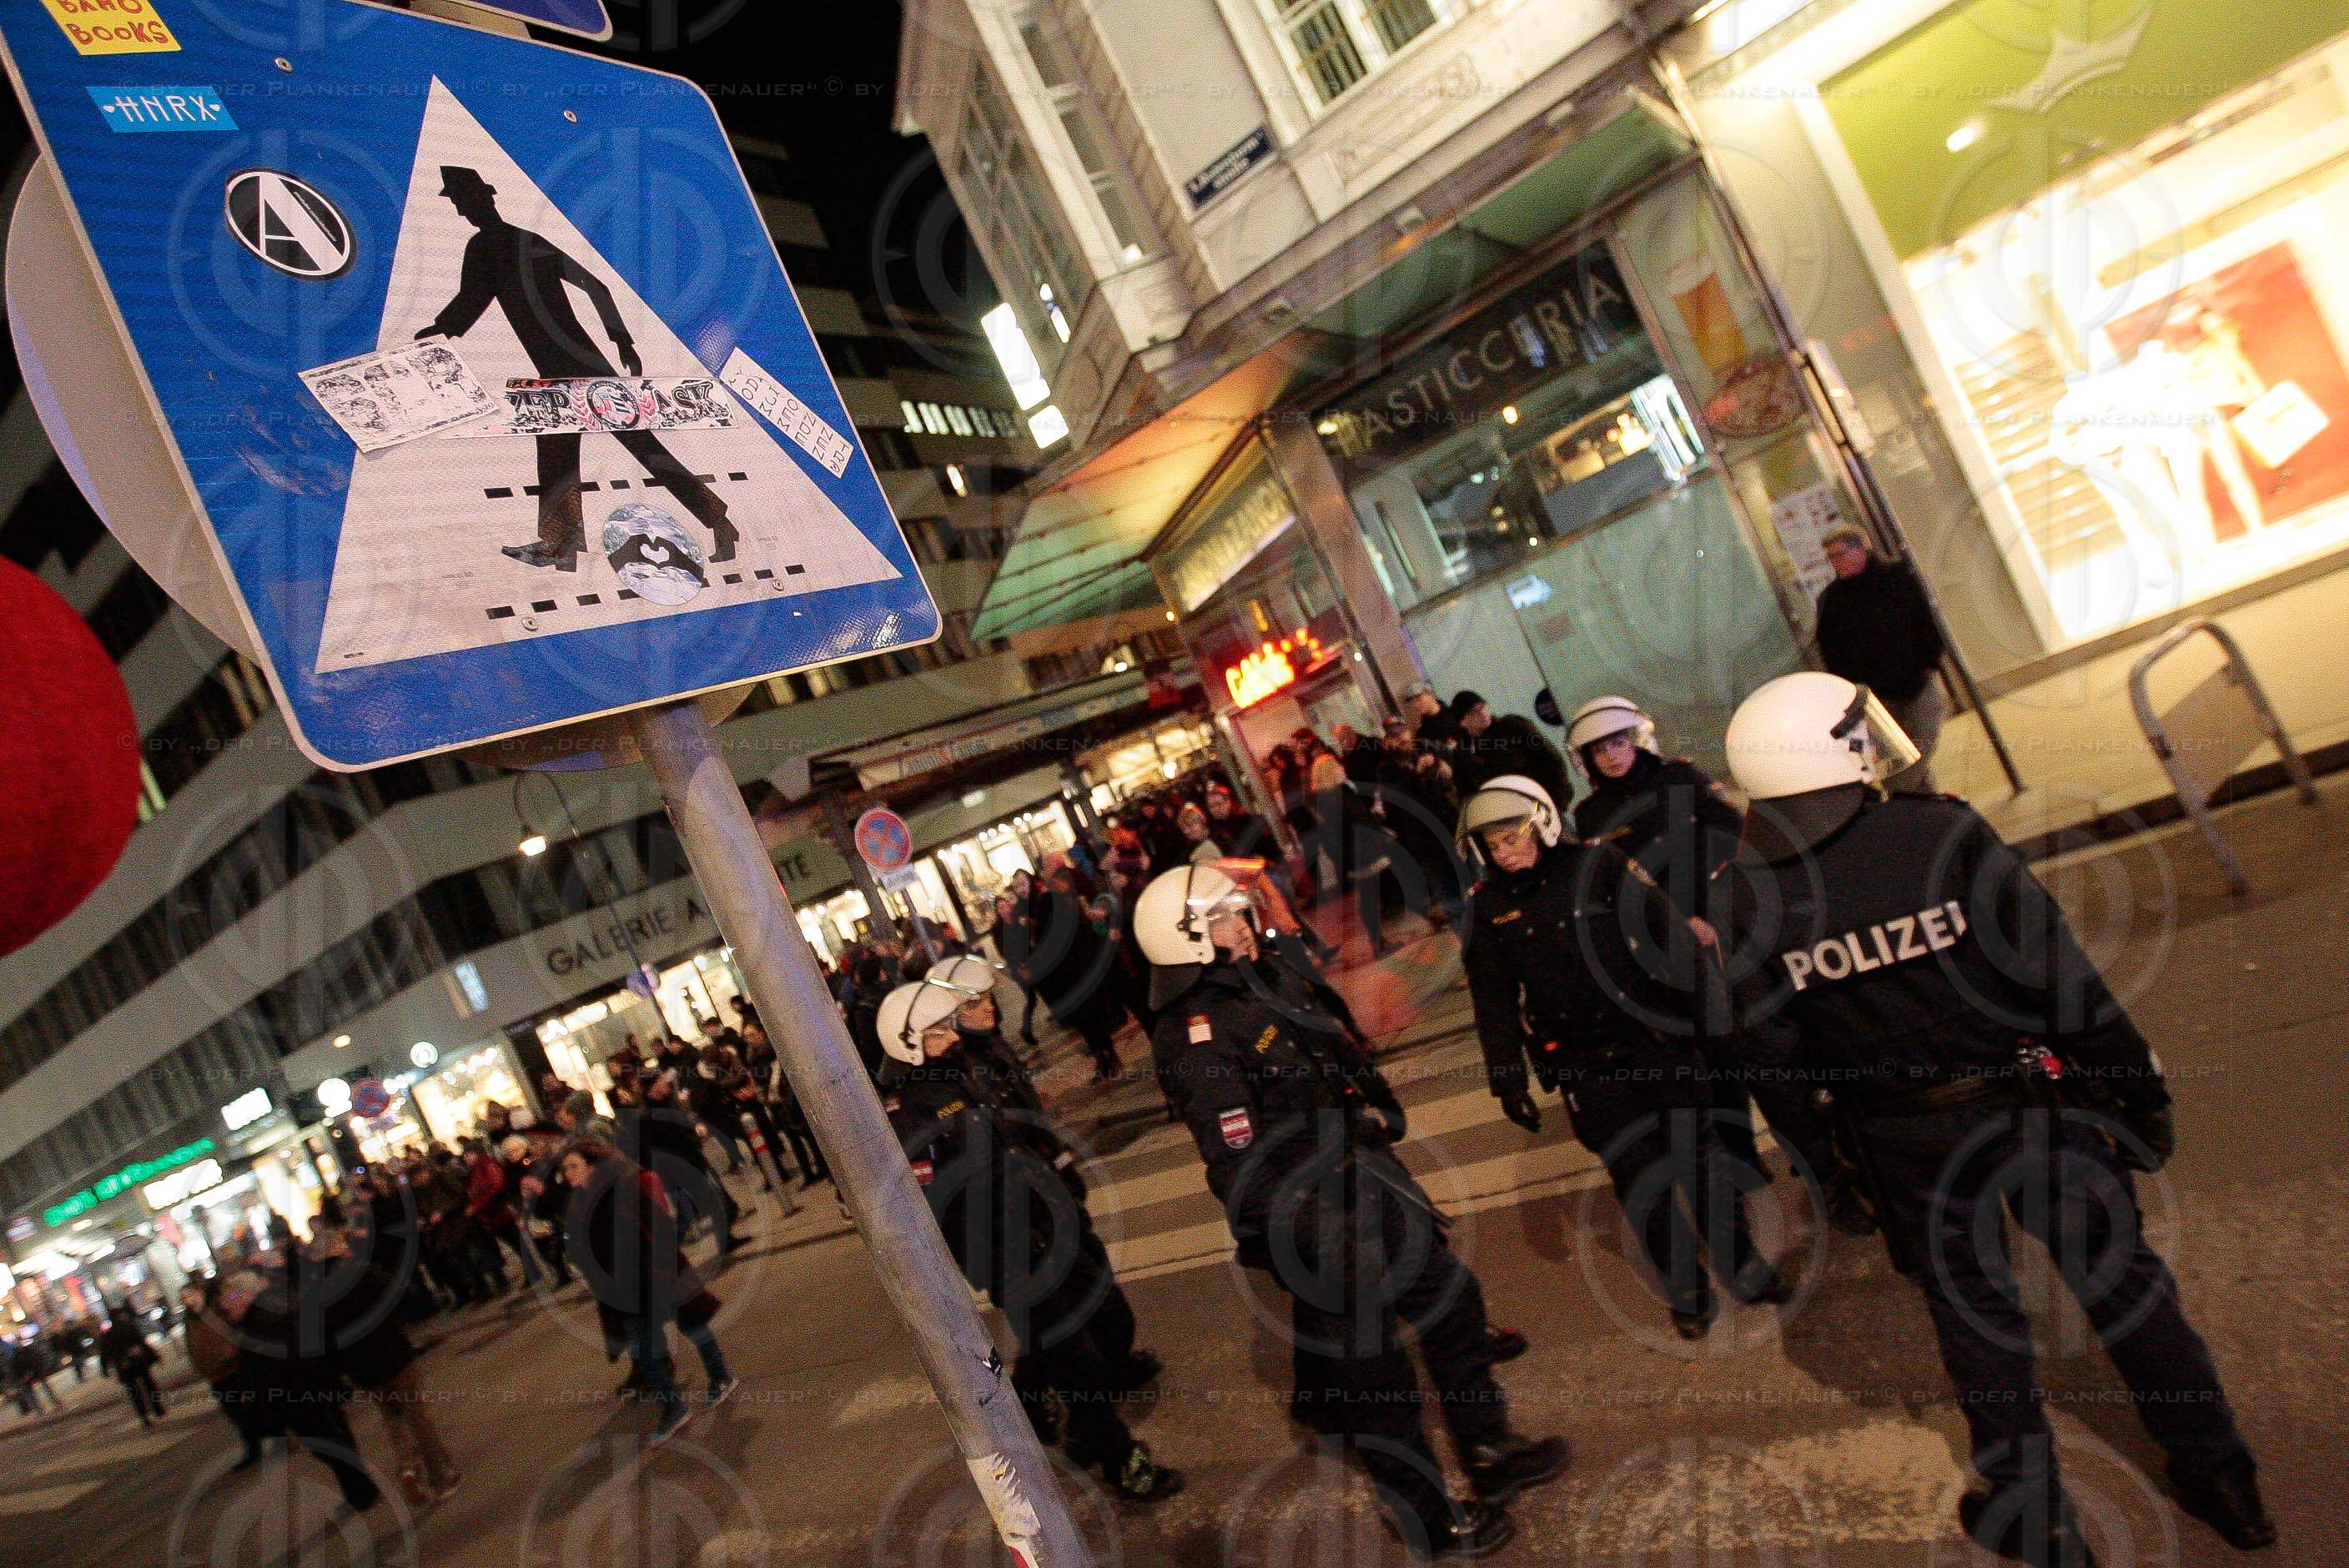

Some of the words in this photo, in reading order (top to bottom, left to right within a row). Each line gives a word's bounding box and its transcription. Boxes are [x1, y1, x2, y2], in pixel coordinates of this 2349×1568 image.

[66, 21, 169, 45] BOOKS
[114, 95, 218, 123] HNRX
[549, 907, 670, 976] GALERIE
[1782, 901, 1968, 991] POLIZEI
